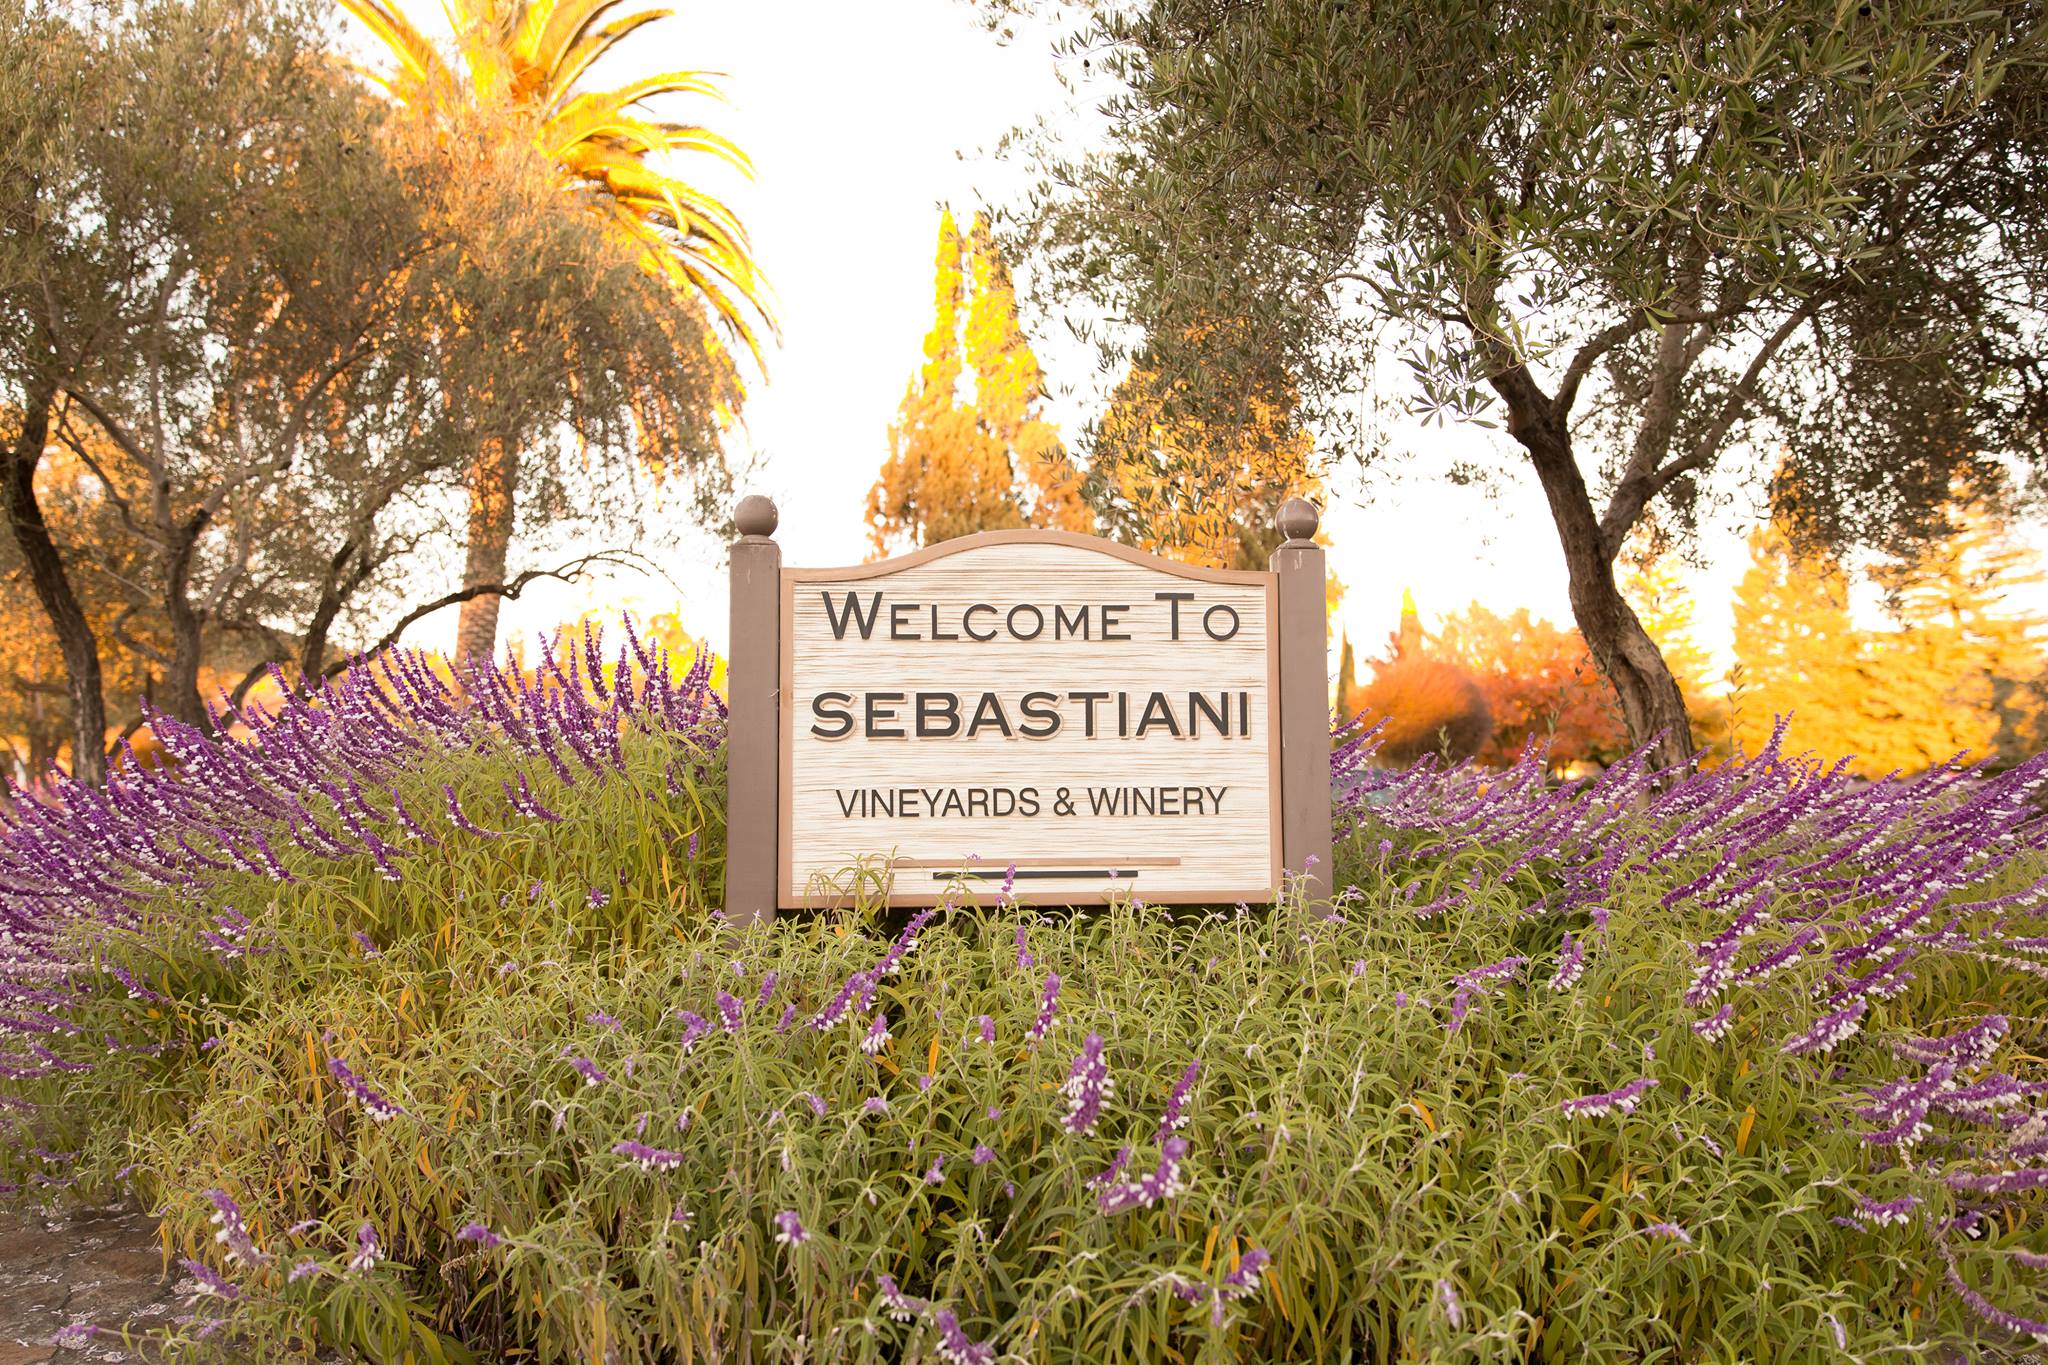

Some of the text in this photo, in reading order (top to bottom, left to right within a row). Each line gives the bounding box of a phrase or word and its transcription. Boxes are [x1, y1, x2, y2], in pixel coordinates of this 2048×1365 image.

[821, 591, 1240, 642] WELCOME TO
[810, 690, 1248, 738] SEBASTIANI
[836, 786, 1227, 818] VINEYARDS & WINERY
